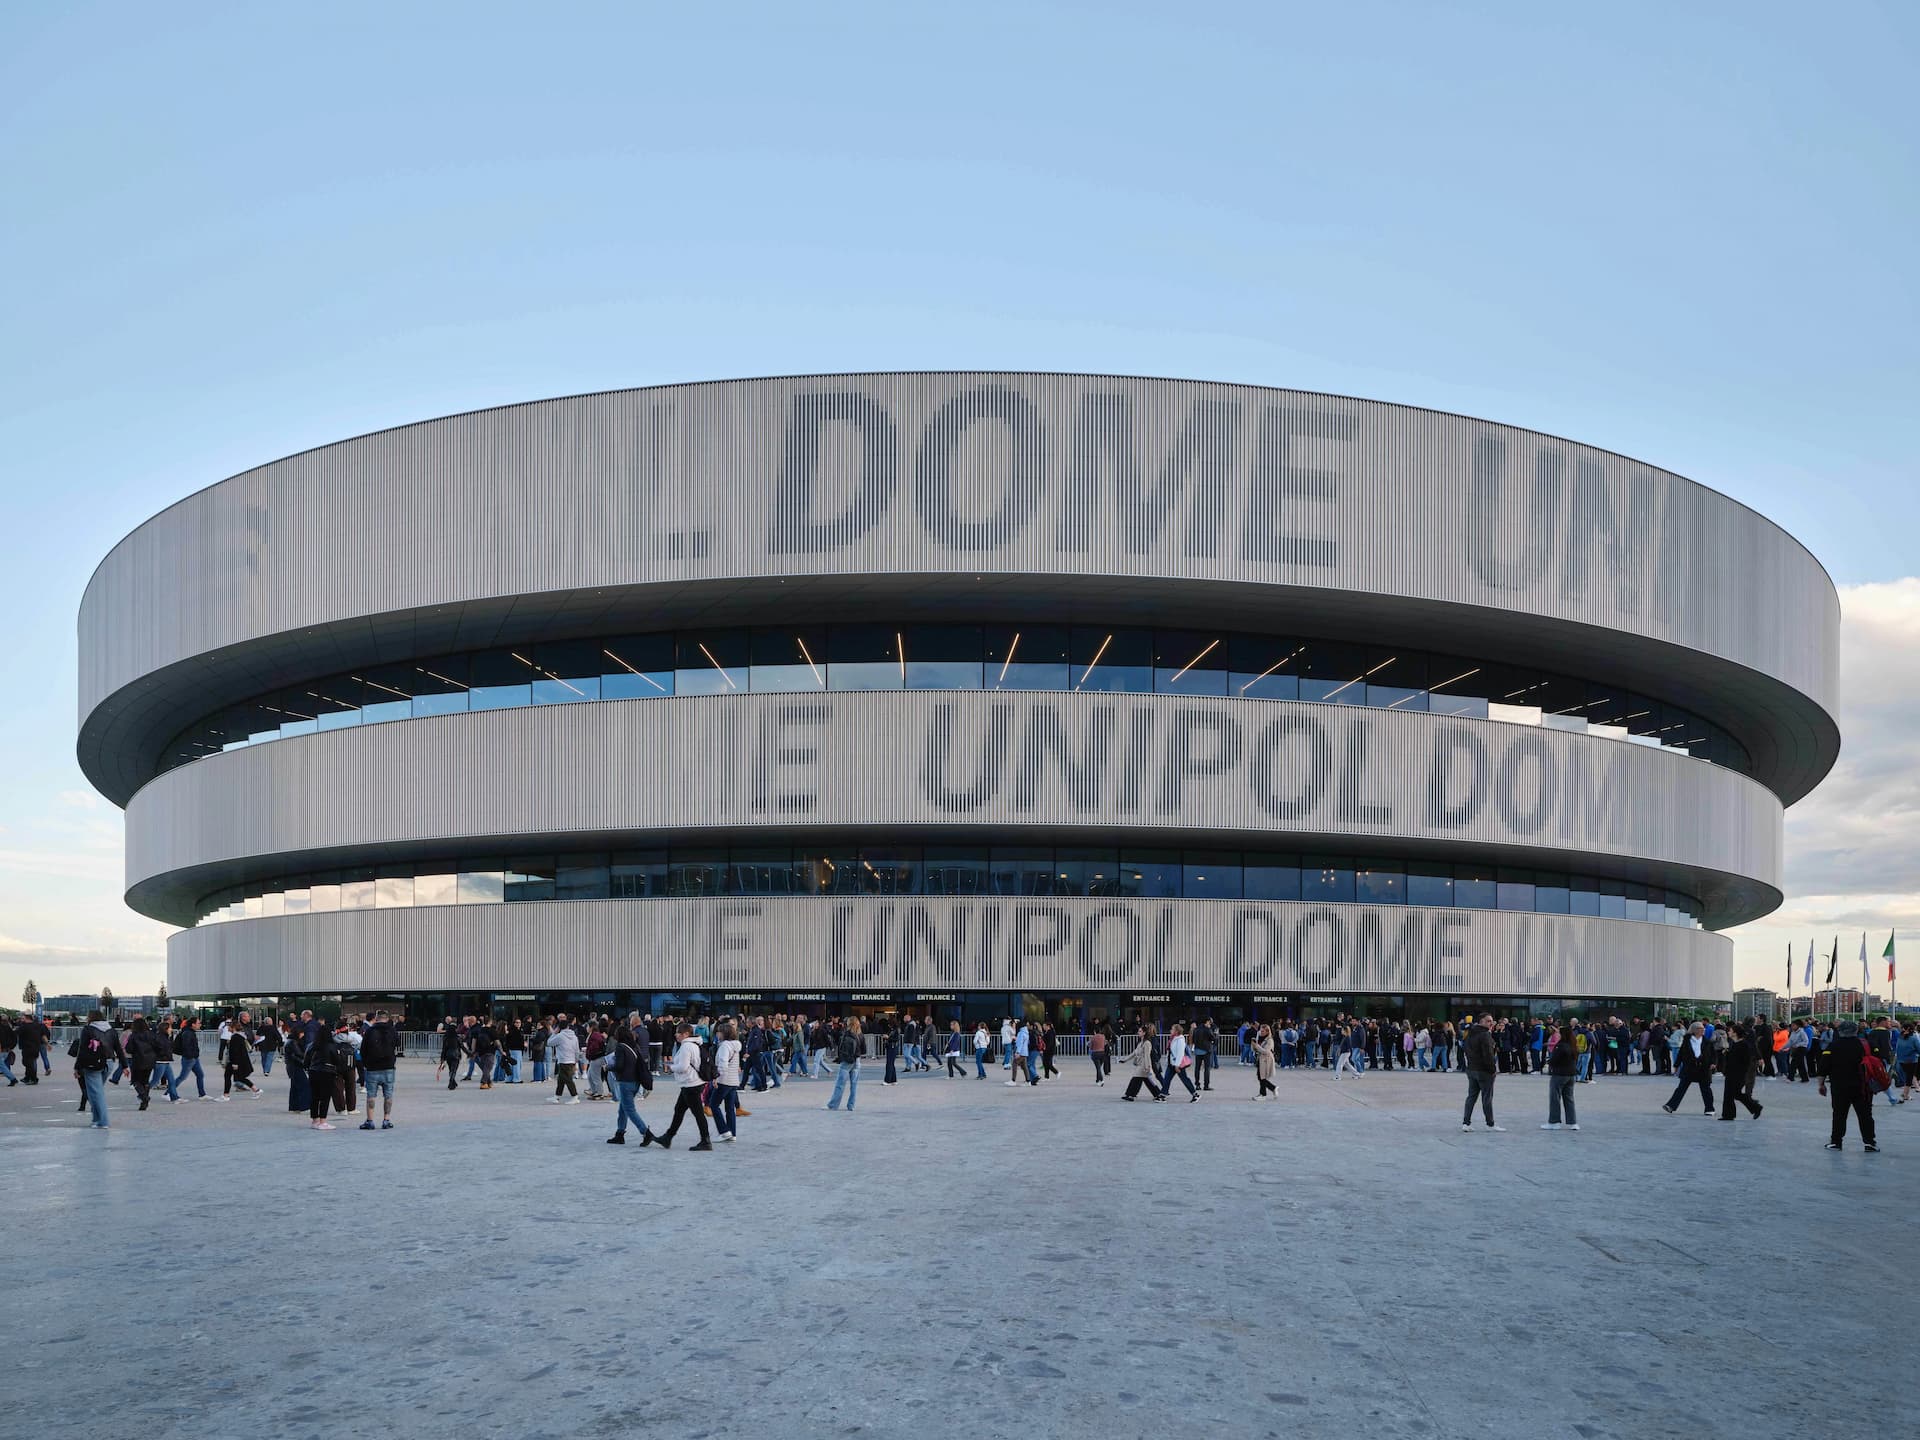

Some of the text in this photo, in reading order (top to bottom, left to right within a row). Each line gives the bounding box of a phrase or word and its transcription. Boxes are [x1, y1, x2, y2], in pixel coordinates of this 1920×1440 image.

[767, 384, 1363, 568] DOME
[920, 704, 1394, 825] UNIPOL
[832, 903, 1194, 984] UNIPOL
[1226, 908, 1473, 988] DOME
[724, 993, 762, 1001] ENTRANCE 2
[787, 993, 826, 1001] ENTRANCE 2
